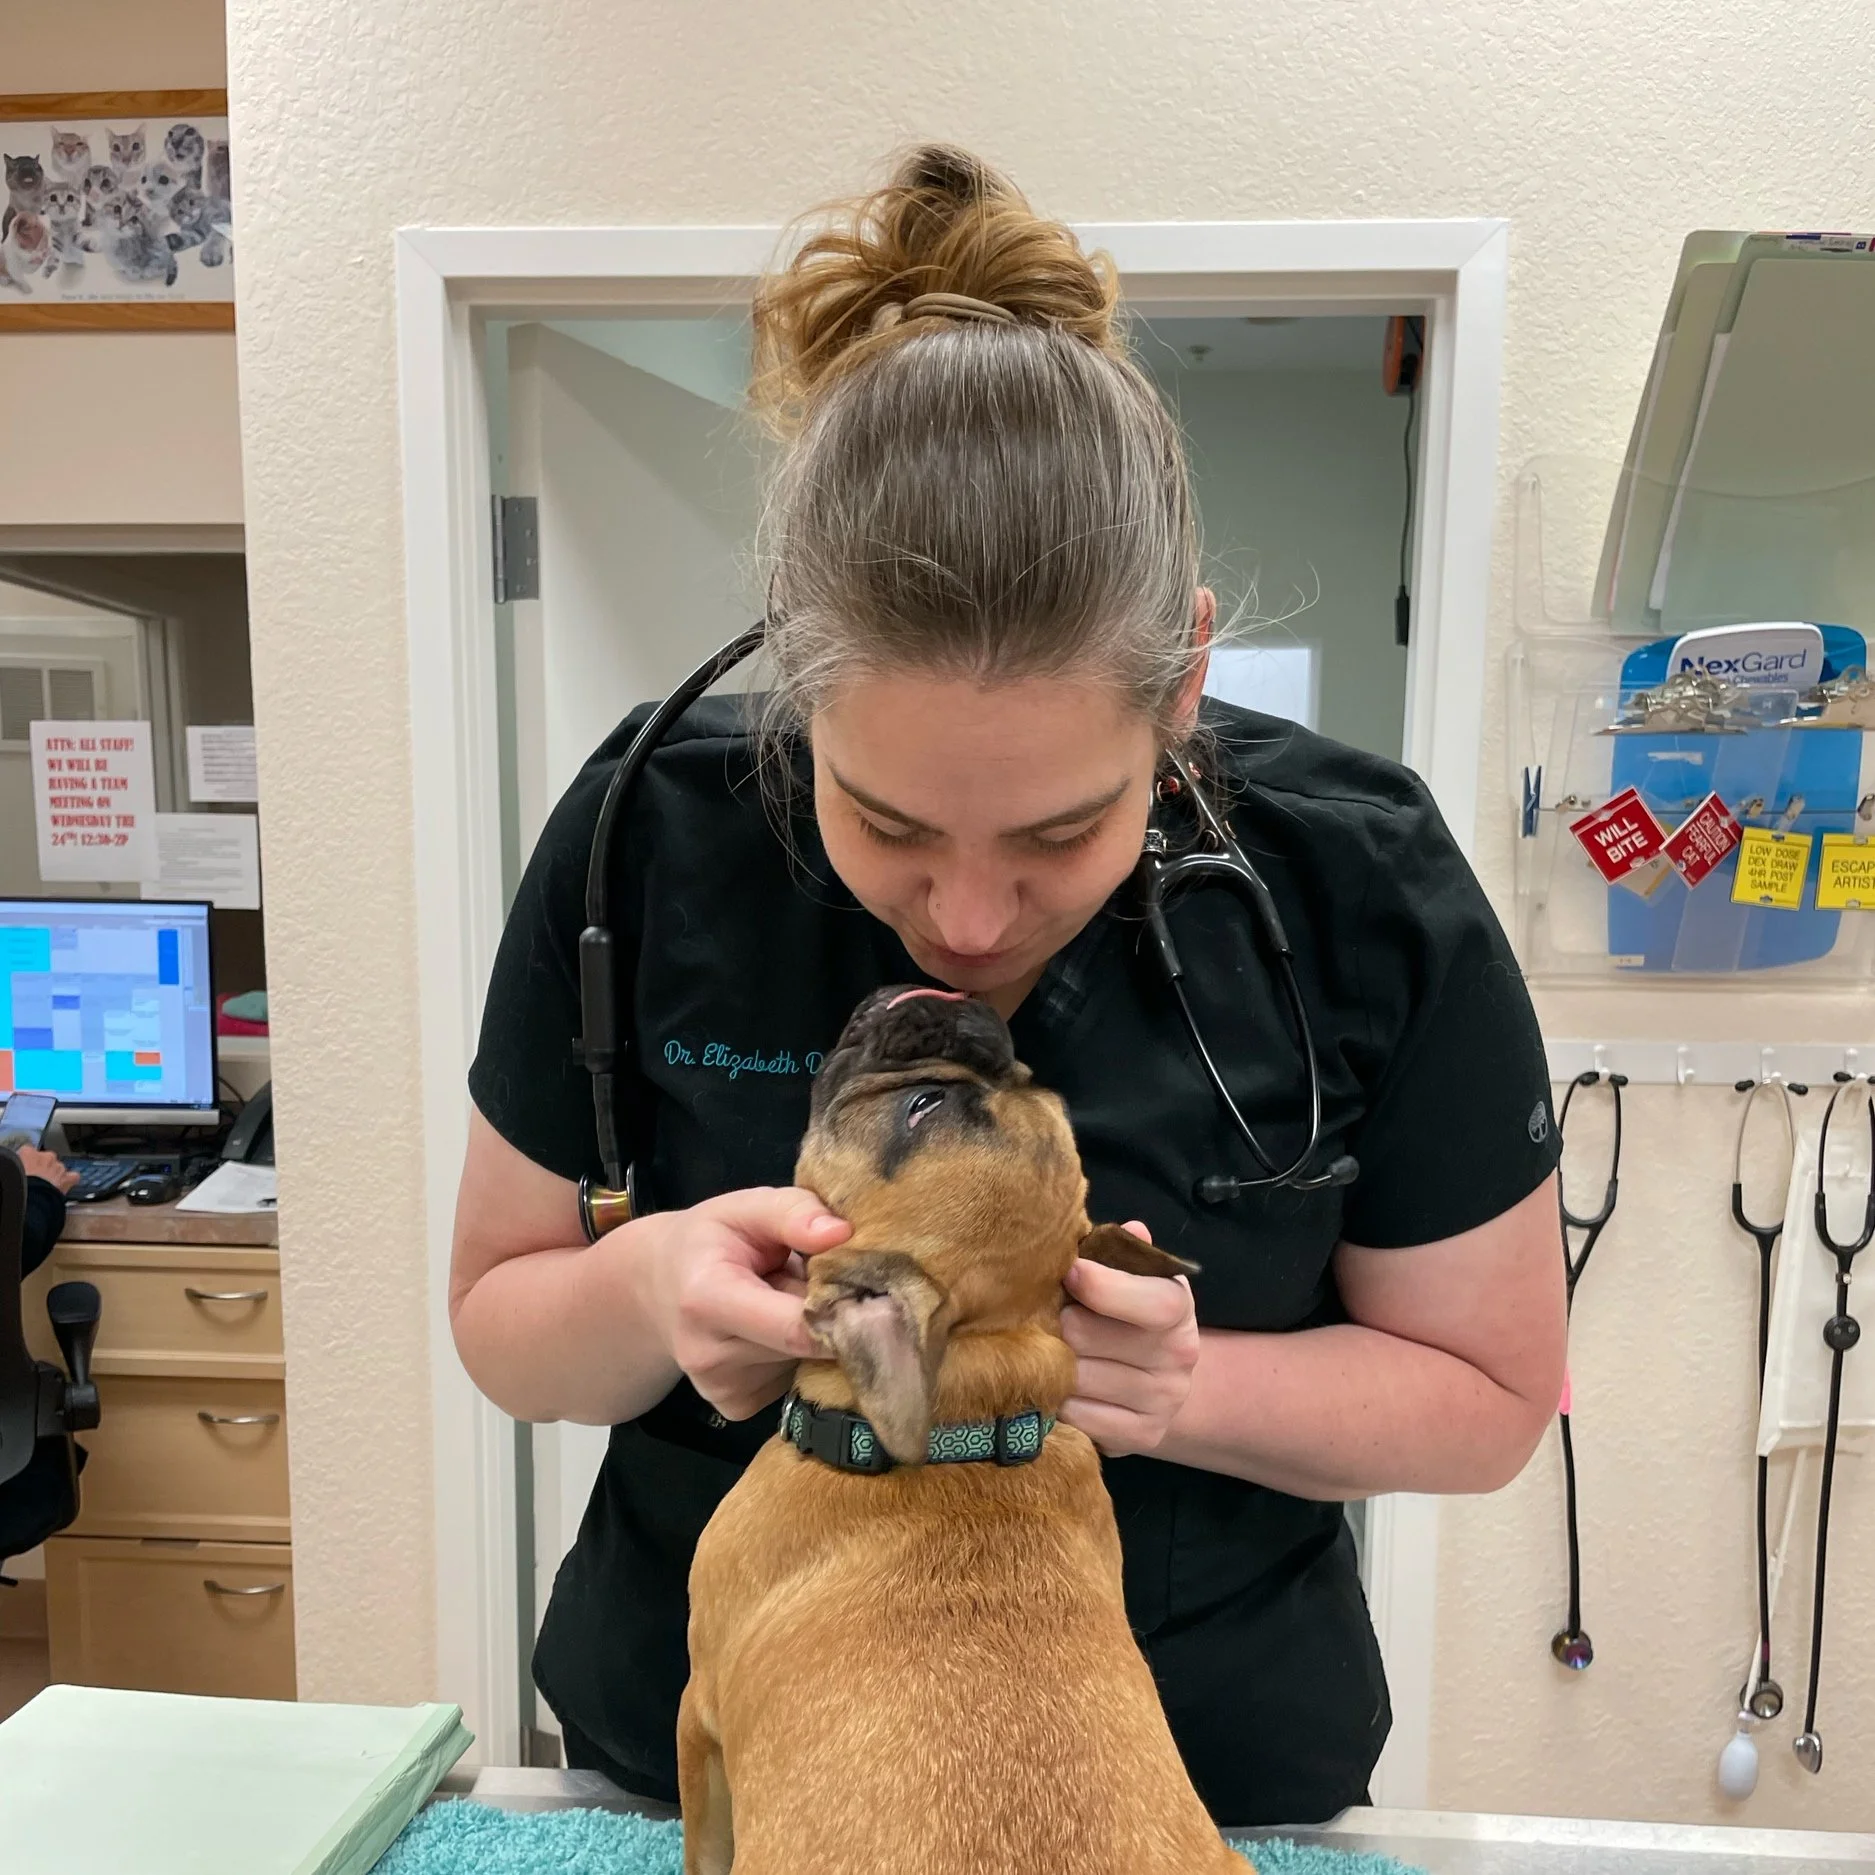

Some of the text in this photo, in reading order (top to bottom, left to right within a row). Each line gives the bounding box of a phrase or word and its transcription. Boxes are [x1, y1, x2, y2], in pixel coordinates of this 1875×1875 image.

[1680, 648, 1807, 676] NexGard
[80, 737, 96, 752] ALL
[48, 758, 108, 771] WE WILL BE
[48, 777, 128, 790] HAVING A TEAM
[49, 796, 111, 809] MEETING ON
[51, 815, 135, 828] WEDNESDAY THE
[1594, 817, 1639, 847] WILL
[1700, 811, 1731, 852] CAUTION
[1606, 830, 1649, 864] BITE
[1685, 823, 1716, 866] FEARFUL
[1750, 845, 1801, 859] LOW DOSE
[1682, 845, 1700, 866] CAT
[1748, 856, 1799, 871] DEX DRAW
[1748, 868, 1794, 882] 4HR POST
[1751, 879, 1788, 893] SAMPLE
[664, 1040, 697, 1065] Dr.
[702, 1043, 800, 1080] Elizabeth
